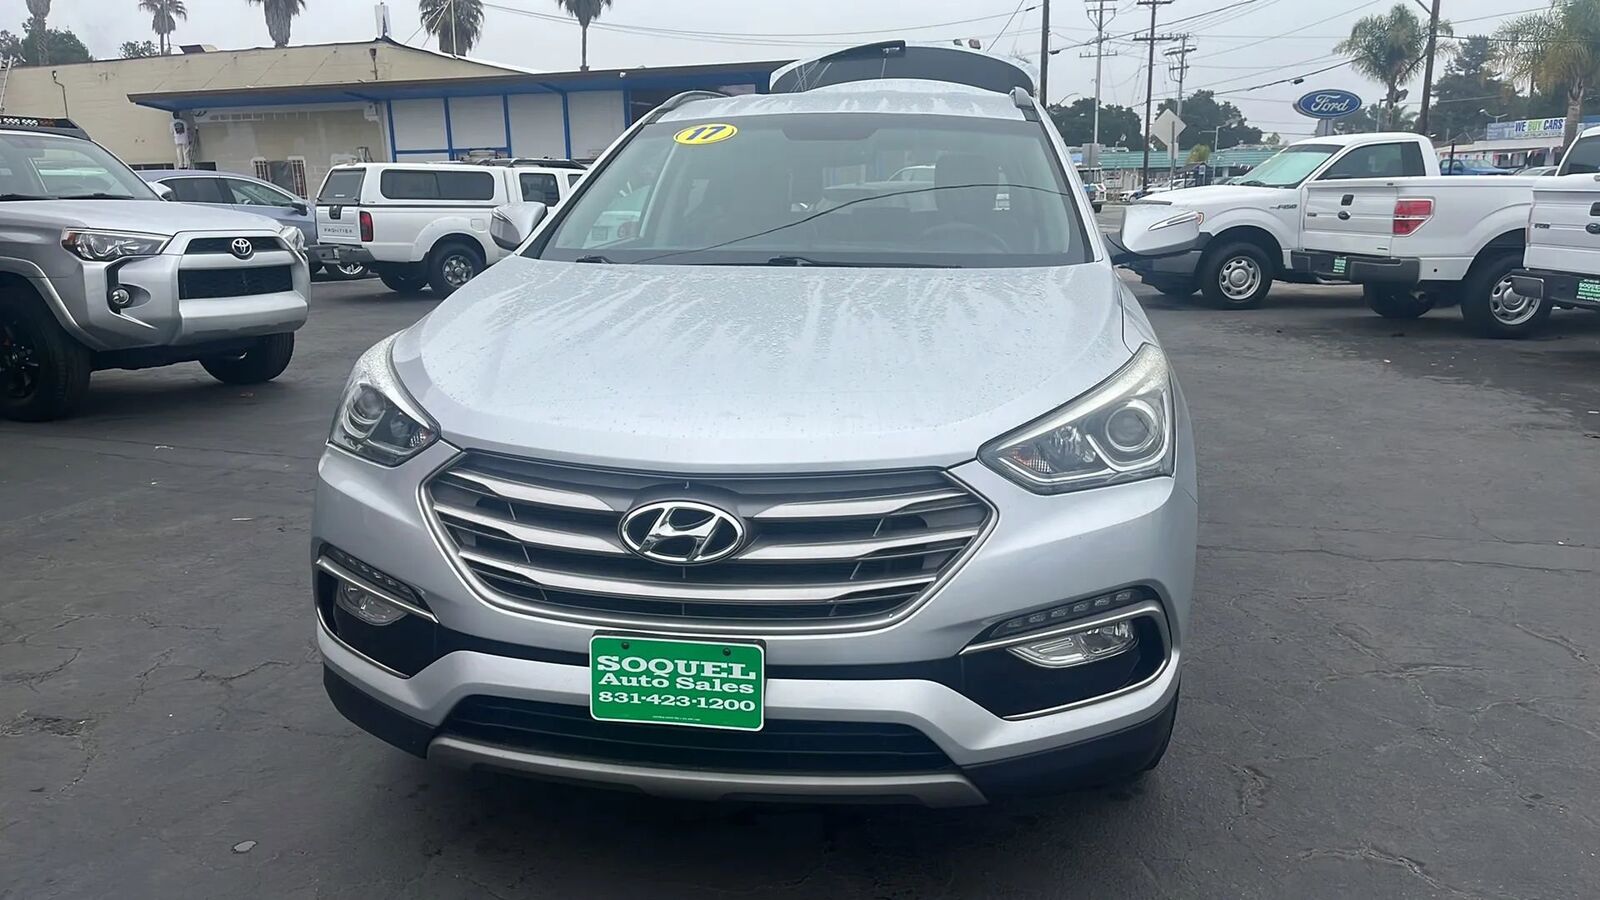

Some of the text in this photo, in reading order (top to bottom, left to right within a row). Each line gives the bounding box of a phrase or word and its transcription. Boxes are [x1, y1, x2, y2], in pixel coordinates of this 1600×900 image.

[1311, 94, 1350, 112] Ford
[686, 126, 726, 140] 17
[1515, 121, 1526, 132] WE
[1527, 120, 1542, 131] BUY
[1543, 119, 1563, 130] CARS
[597, 655, 756, 680] SOQUEL
[598, 672, 754, 694] Auto Sales
